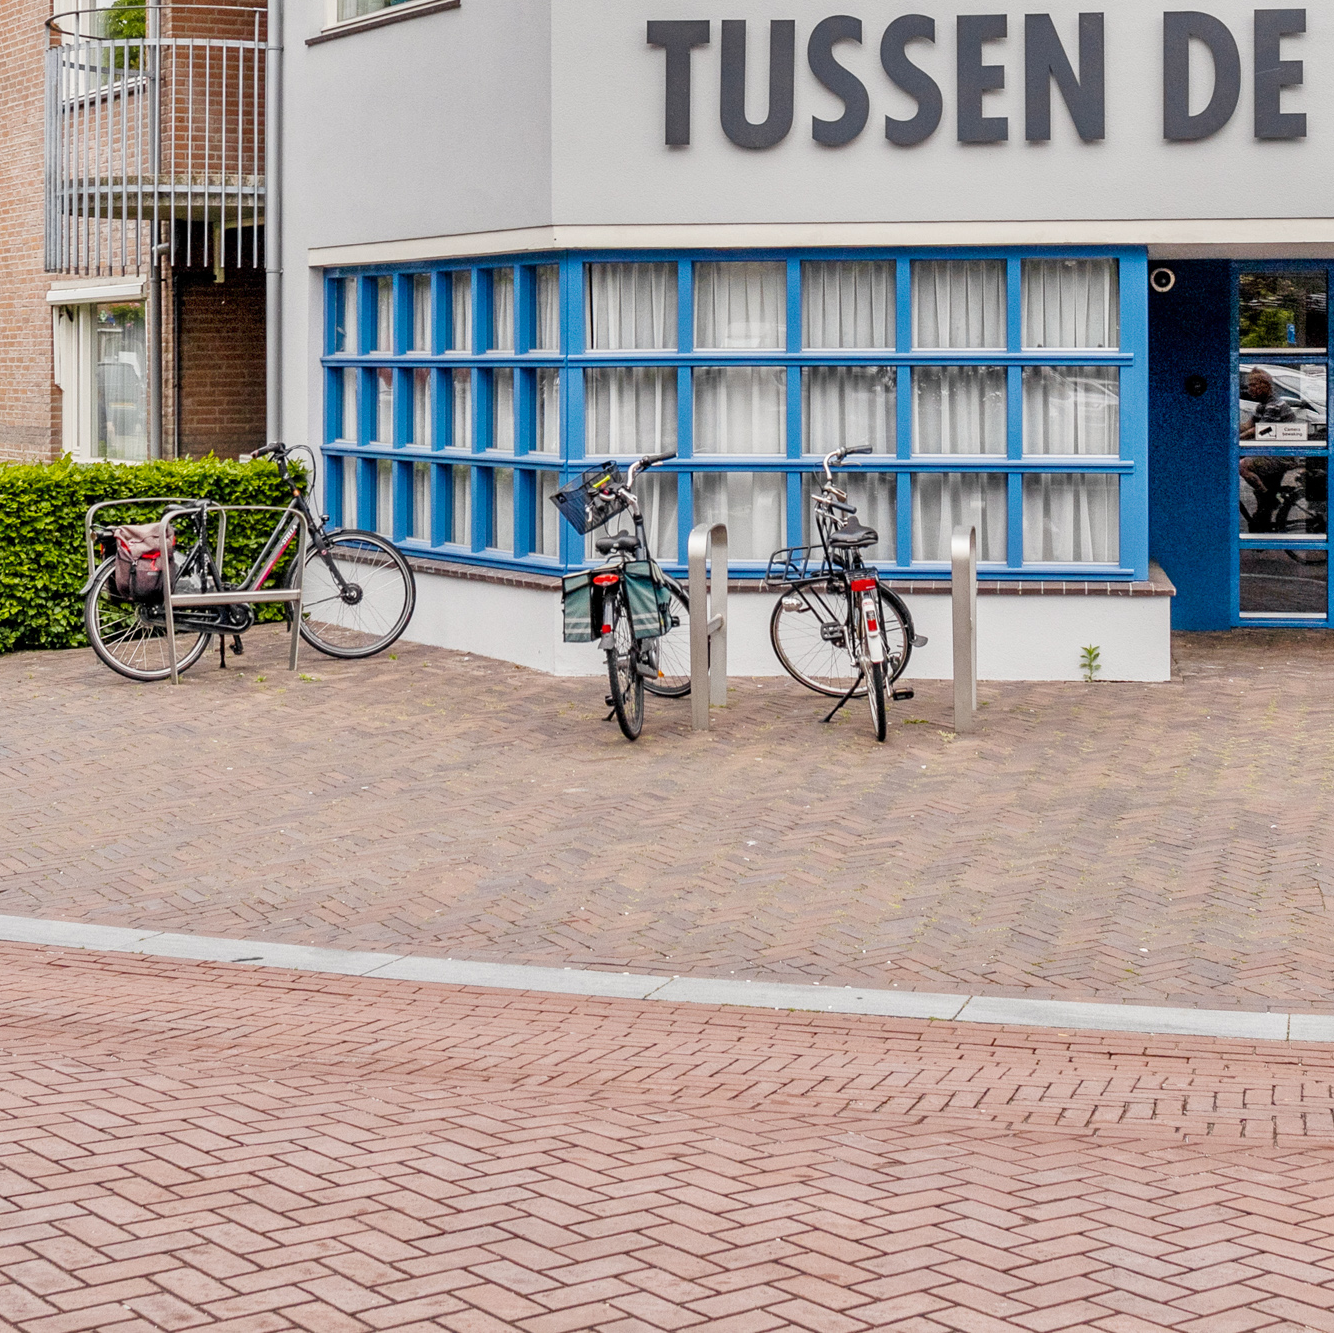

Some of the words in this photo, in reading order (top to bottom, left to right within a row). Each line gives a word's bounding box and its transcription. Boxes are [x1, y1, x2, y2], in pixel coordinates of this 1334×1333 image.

[646, 11, 1106, 153] TUSSEN
[1162, 8, 1308, 145] DE
[281, 524, 298, 545] STELLA
